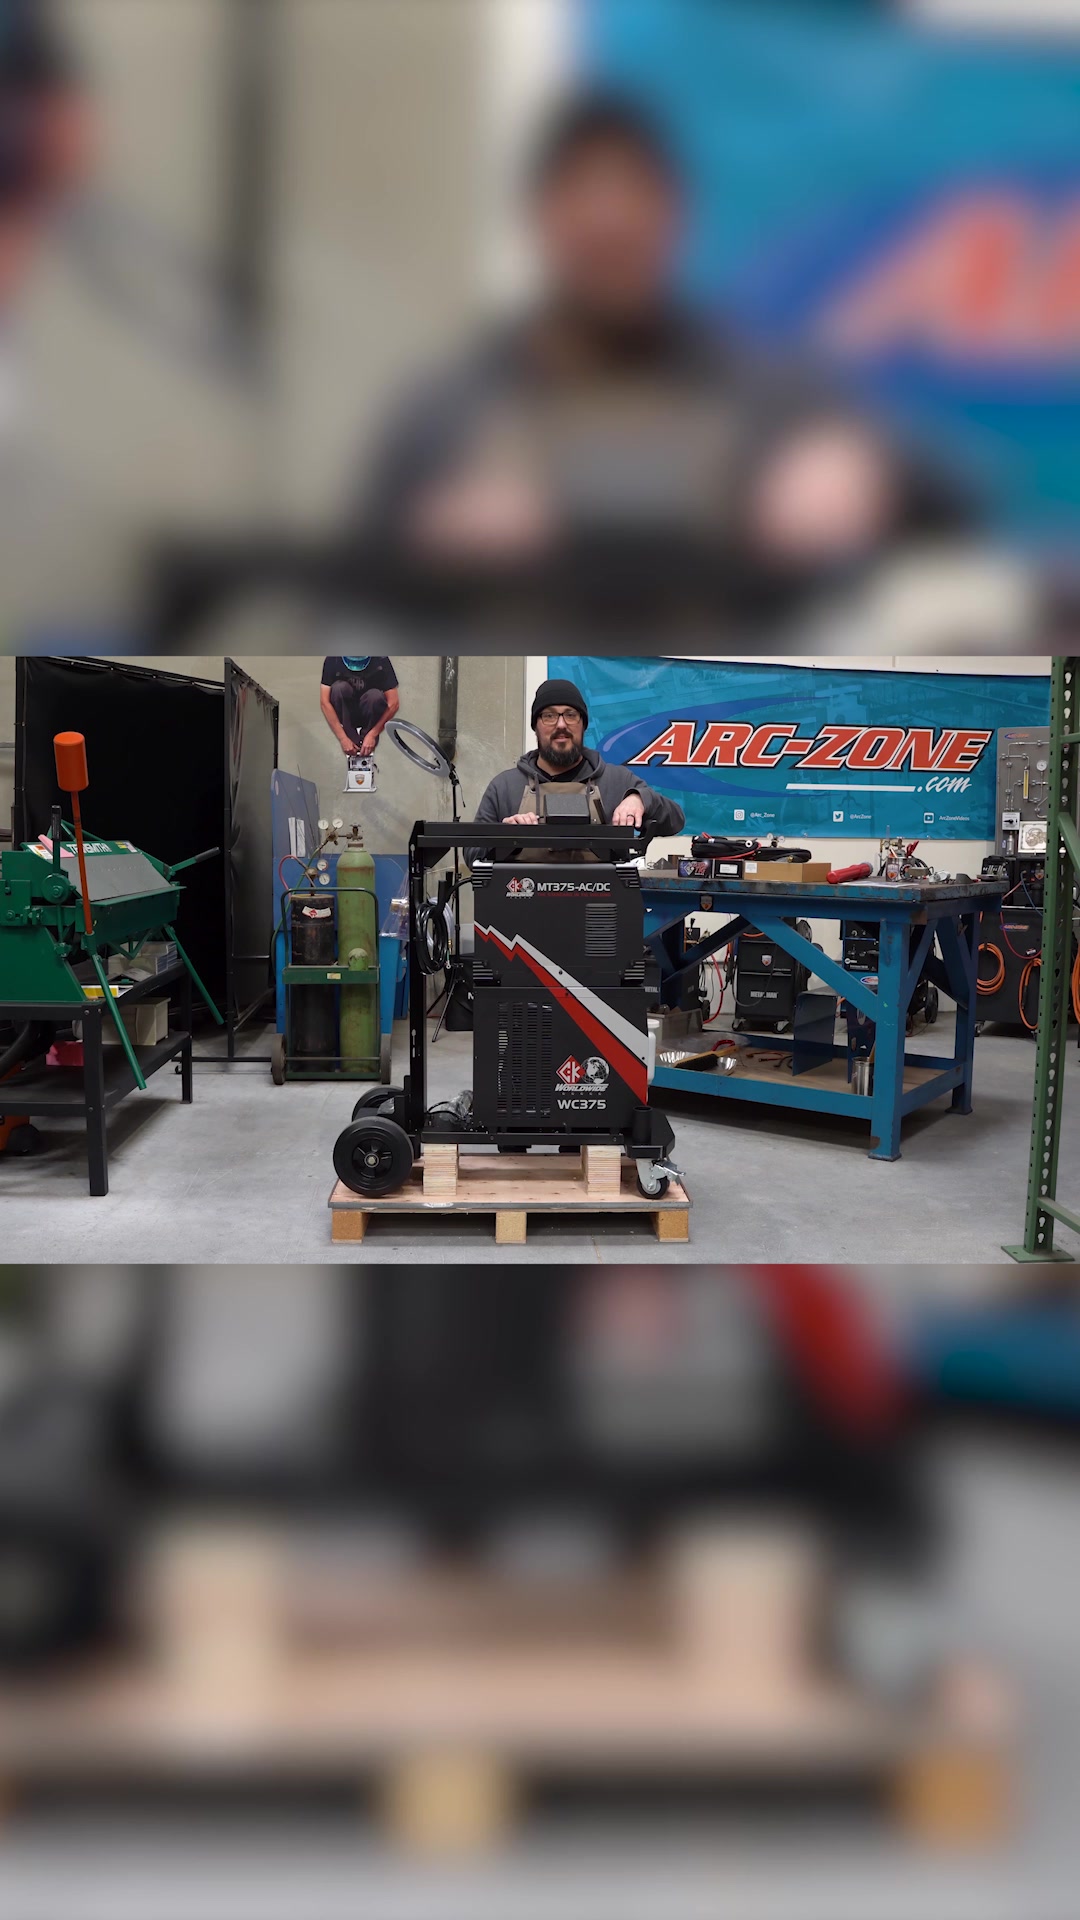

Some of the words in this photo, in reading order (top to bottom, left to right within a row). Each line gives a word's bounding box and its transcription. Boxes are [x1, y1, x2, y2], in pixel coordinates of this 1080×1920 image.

[624, 719, 995, 774] ARC-ZONE
[917, 776, 972, 793] .com
[537, 882, 610, 892] MT375-AC/DC
[555, 1083, 609, 1092] WORLDWIDE
[557, 1099, 607, 1110] WC375
